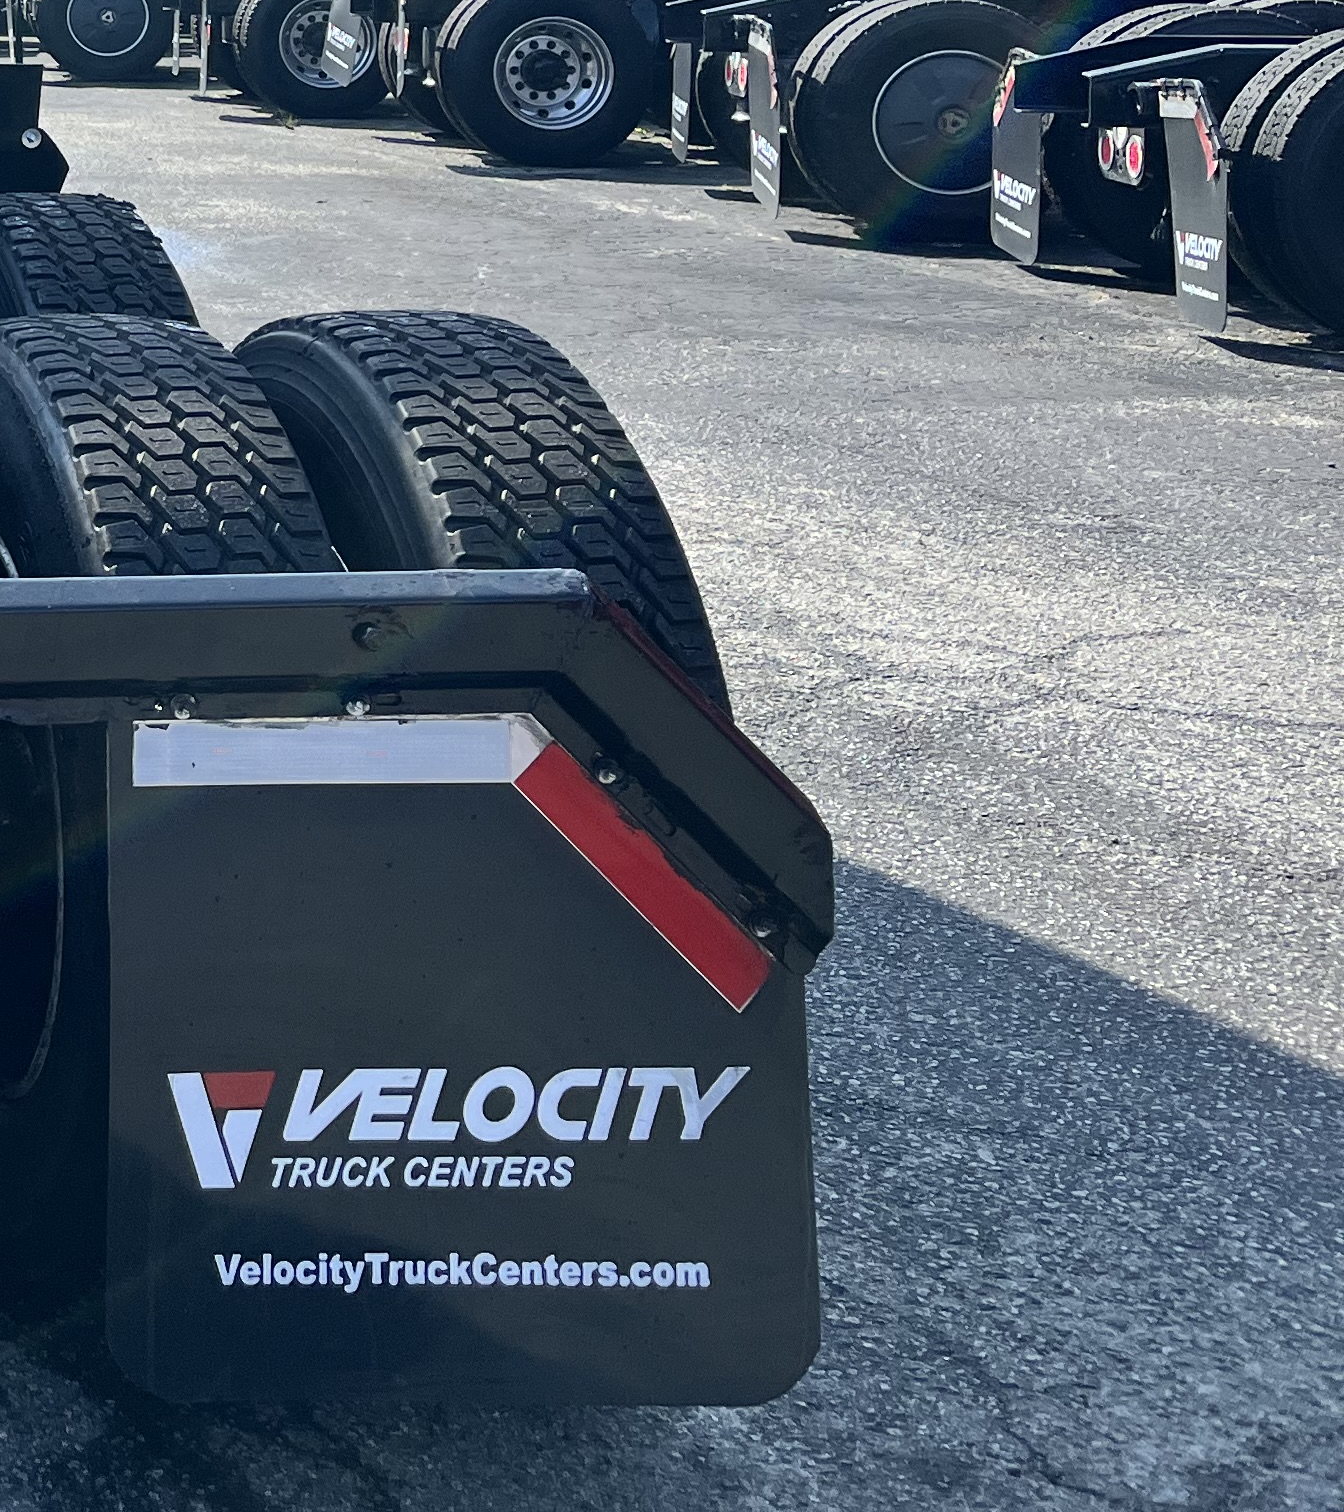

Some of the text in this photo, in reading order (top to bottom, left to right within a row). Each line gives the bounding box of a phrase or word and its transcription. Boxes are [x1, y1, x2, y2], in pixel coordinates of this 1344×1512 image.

[282, 1065, 752, 1143] VELOCITY
[270, 1155, 576, 1189] TRUCK CENTERS
[213, 1251, 712, 1294] VelocityTruckCenters.com
